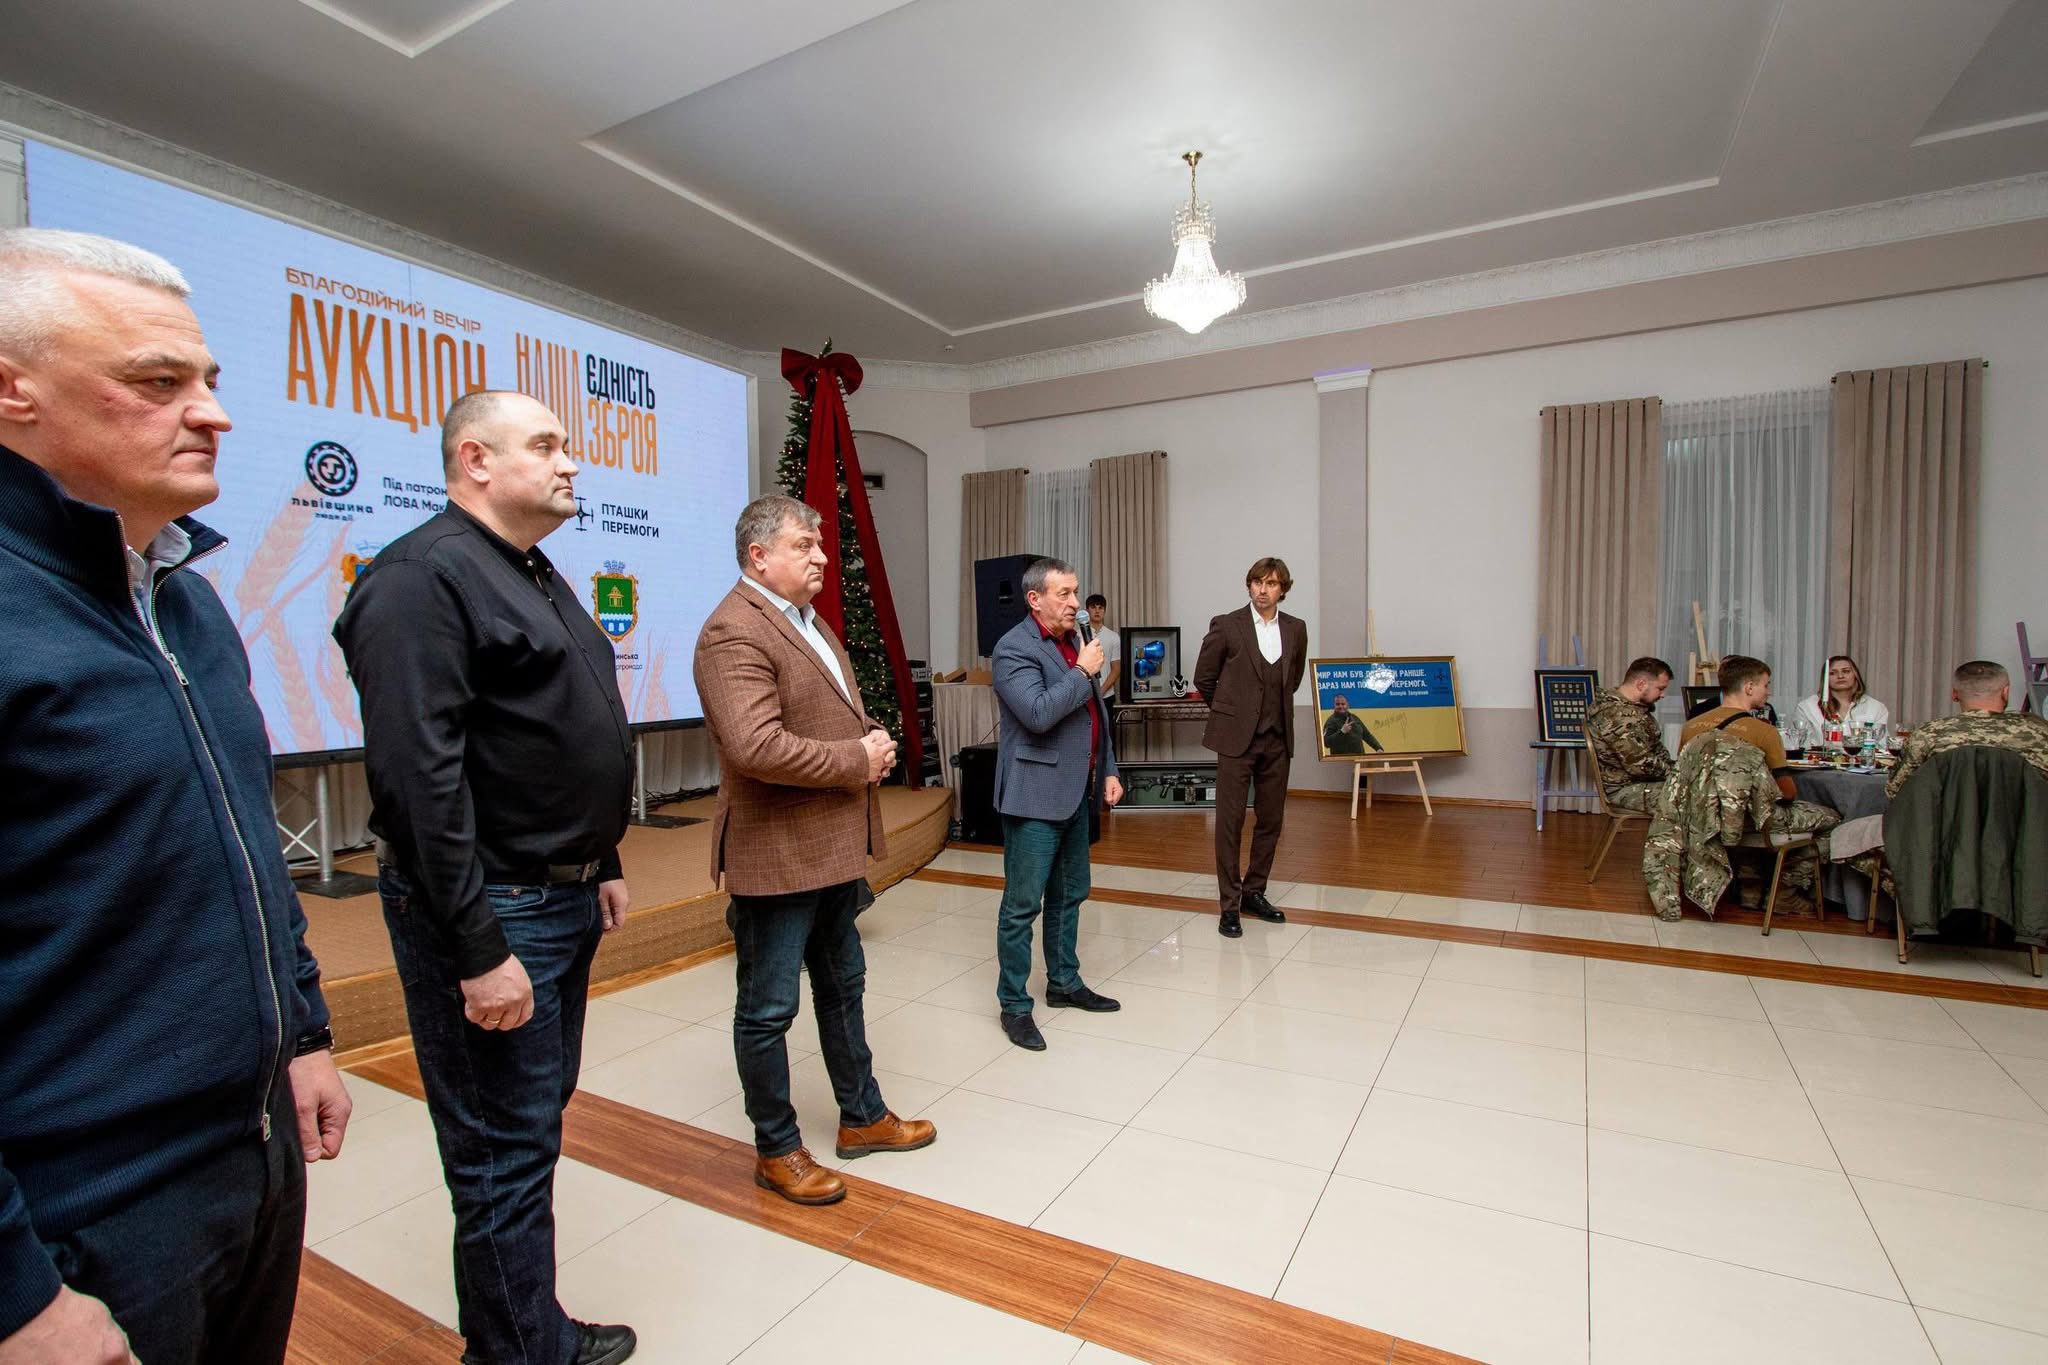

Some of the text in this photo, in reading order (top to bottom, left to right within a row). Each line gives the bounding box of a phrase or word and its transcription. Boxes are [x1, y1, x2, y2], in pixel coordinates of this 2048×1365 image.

[286, 266, 481, 334] БЛАГОДІЙНИЙ ВЕЧІР
[287, 292, 487, 434] АУКЦІОН
[586, 353, 656, 410] ЄДНІСТЬ
[587, 397, 658, 477] ЗБРОЯ
[382, 476, 447, 496] Під патрон
[383, 494, 447, 513] ЛОВА Мак
[601, 503, 649, 521] ПТАШКИ
[602, 520, 660, 538] ПЕРЕМОГИ
[1317, 671, 1331, 679] МИР
[1333, 670, 1348, 679] НАМ
[1349, 670, 1364, 678] БУВ
[1317, 681, 1339, 690] ЗАРАЗ
[1341, 681, 1356, 689] НАМ
[1391, 680, 1428, 688] ПЕРЕМОГА.
